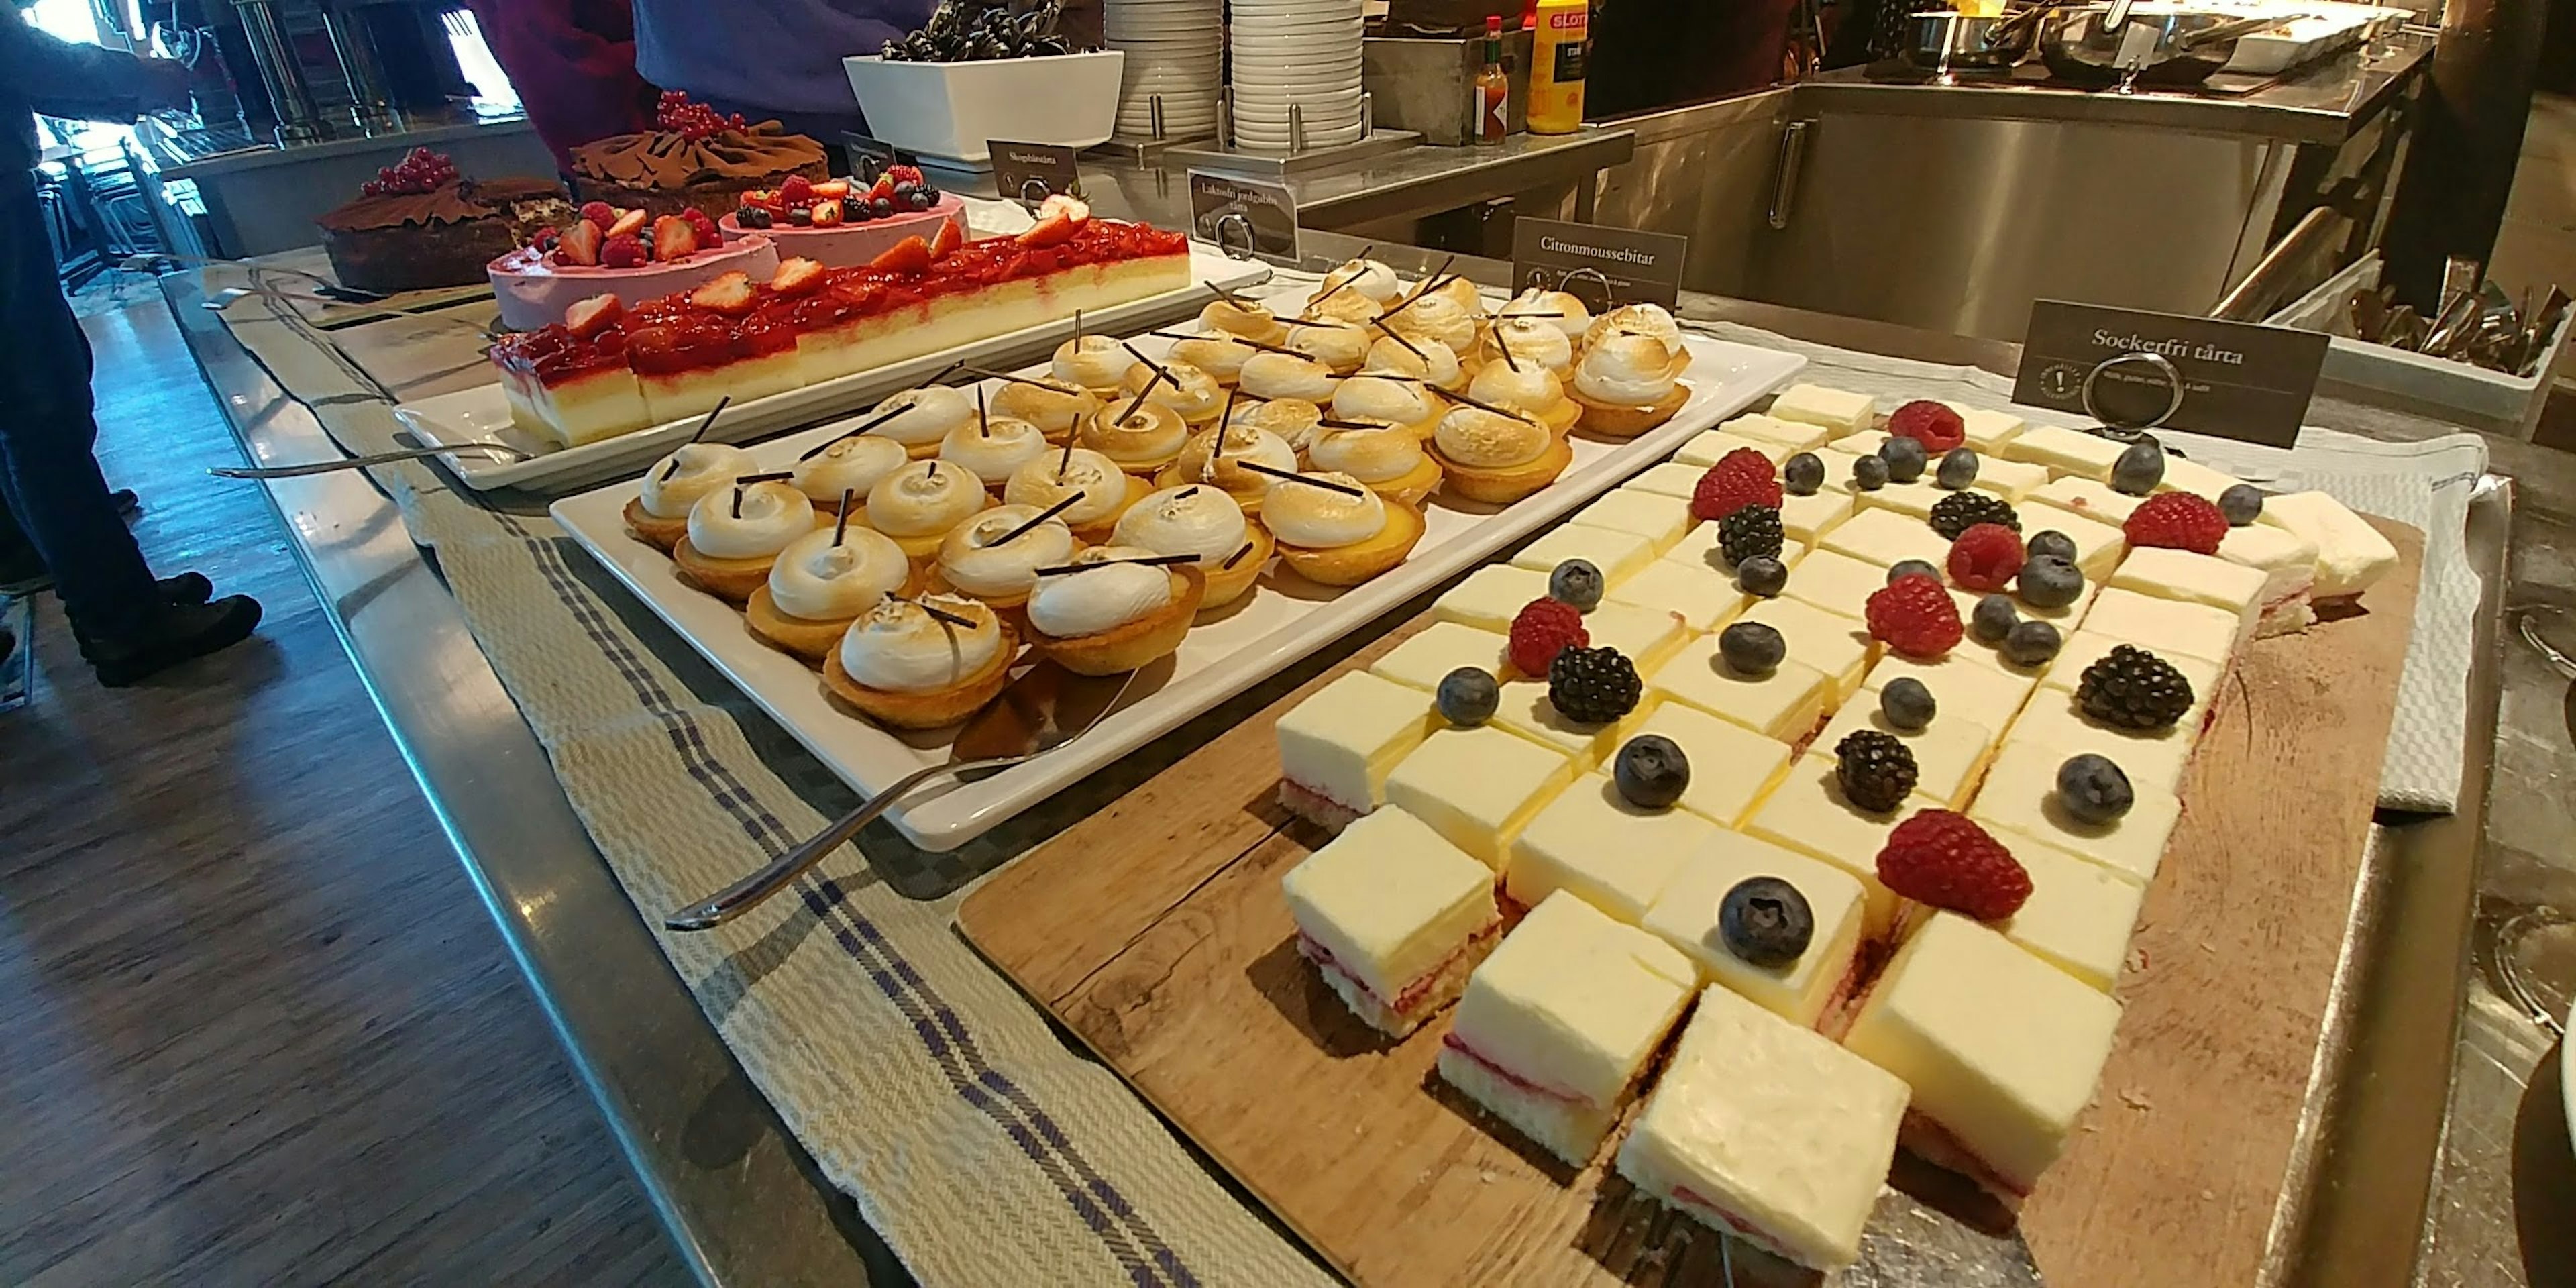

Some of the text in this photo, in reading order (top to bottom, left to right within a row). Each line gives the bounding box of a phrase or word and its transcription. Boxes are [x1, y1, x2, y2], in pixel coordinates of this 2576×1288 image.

[1201, 182, 1236, 199] Laktosfri
[1540, 235, 1655, 266] Citronmoussebitar
[2092, 327, 2243, 365] Sockerfri tårta
